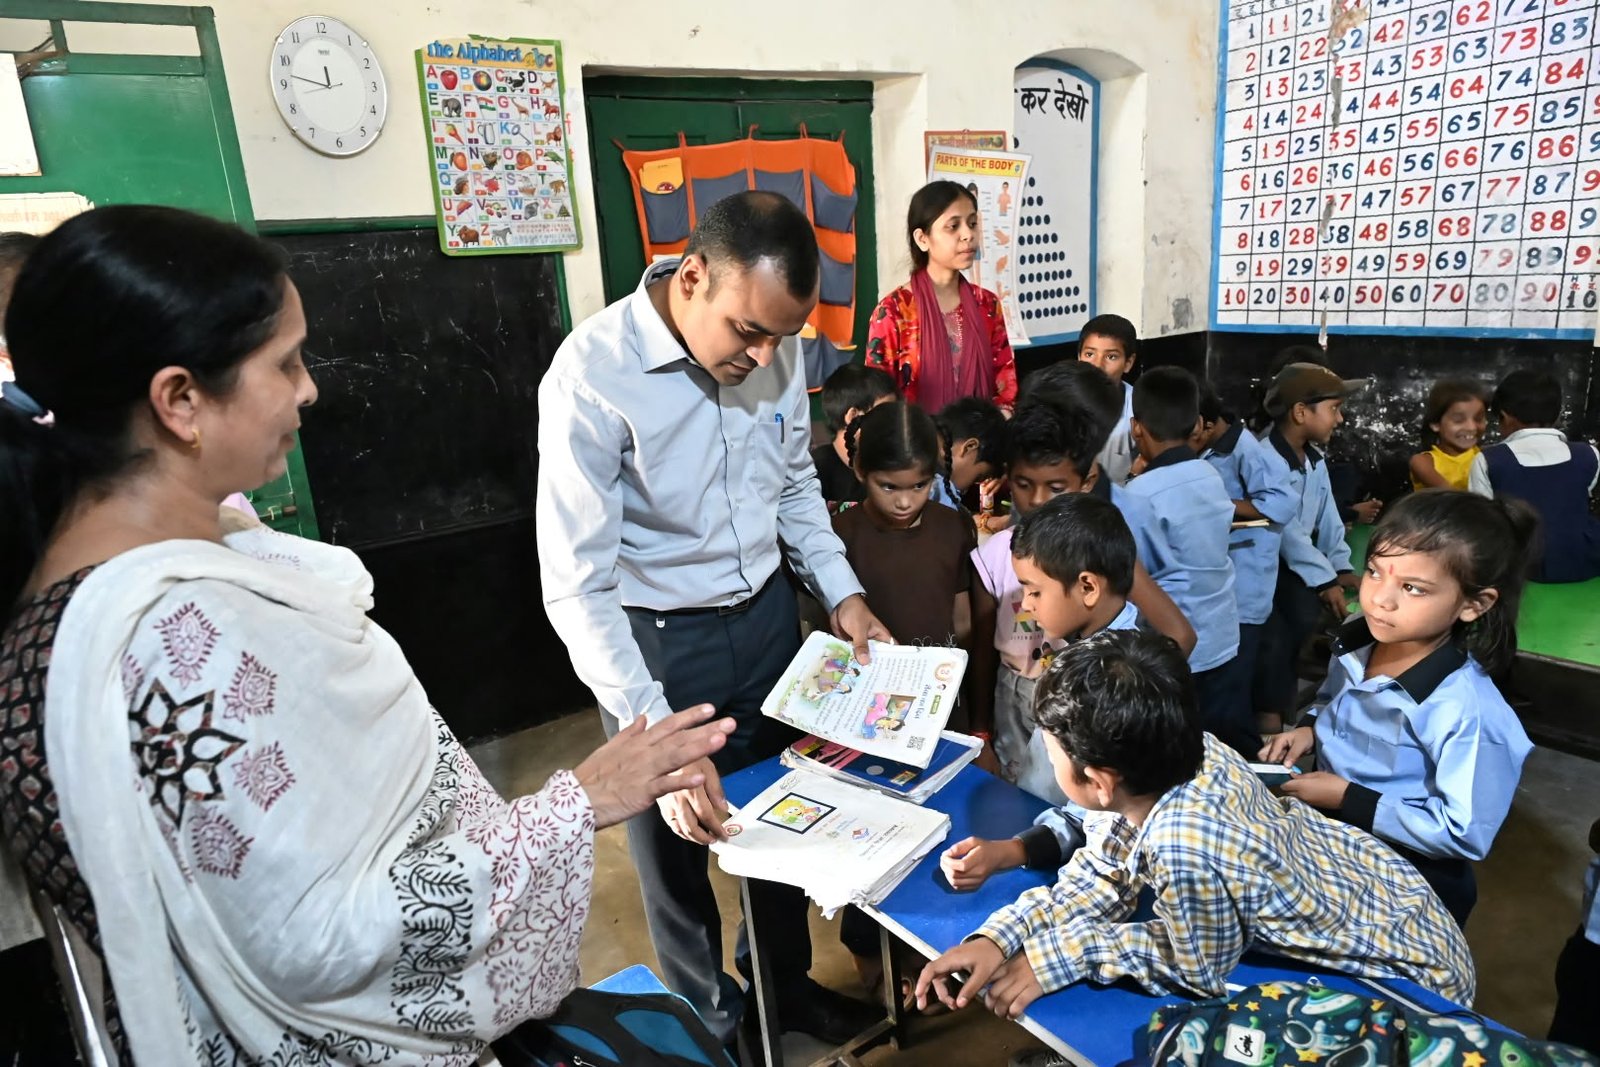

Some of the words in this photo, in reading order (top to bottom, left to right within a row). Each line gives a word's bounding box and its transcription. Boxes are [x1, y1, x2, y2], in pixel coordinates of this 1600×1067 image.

[316, 22, 326, 33] 12
[1249, 23, 1254, 39] 1
[1269, 14, 1288, 35] 11
[1302, 5, 1325, 27] 21
[292, 31, 300, 43] 11
[348, 35, 351, 46] 1
[1246, 52, 1256, 72] 2
[1267, 46, 1290, 67] 12
[1300, 37, 1327, 60] 22
[1374, 20, 1404, 43] 42
[1415, 10, 1447, 35] 52
[1456, 0, 1490, 26] 62
[457, 41, 522, 64] Alphabet
[1245, 83, 1255, 101] 3
[1266, 77, 1288, 98] 13
[1298, 69, 1325, 92] 23
[1372, 54, 1402, 76] 43
[1412, 45, 1444, 70] 53
[1453, 36, 1488, 64] 63
[1500, 27, 1537, 54] 73
[1549, 16, 1589, 45] 83
[280, 55, 291, 66] 10
[363, 58, 370, 69] 2
[426, 65, 438, 79] A
[460, 67, 471, 79] B
[495, 69, 505, 82] C
[528, 71, 537, 83] D
[280, 79, 287, 89] 9
[371, 82, 377, 92] 3
[429, 92, 439, 105] E
[463, 94, 471, 106] F
[498, 96, 509, 108] G
[531, 97, 540, 109] H
[1021, 87, 1050, 114] कर
[1054, 78, 1089, 122] देखो
[1243, 115, 1253, 130] 4
[1264, 110, 1288, 129] 14
[1296, 103, 1322, 124] 24
[1368, 90, 1399, 110] 44
[1410, 82, 1440, 105] 54
[1450, 75, 1484, 98] 64
[1497, 67, 1532, 91] 74
[1545, 58, 1584, 84] 84
[290, 104, 296, 114] 8
[370, 105, 376, 115] 4
[309, 128, 315, 138] 7
[360, 126, 366, 137] 5
[432, 120, 436, 132] I
[467, 121, 474, 133] J
[501, 122, 510, 134] K
[533, 123, 542, 134] L
[1242, 145, 1252, 162] 5
[1263, 140, 1286, 159] 15
[1294, 134, 1320, 155] 25
[1329, 129, 1356, 150] 35
[1366, 123, 1396, 144] 45
[1406, 117, 1438, 139] 55
[1447, 111, 1482, 134] 65
[1494, 103, 1530, 128] 75
[1540, 96, 1581, 124] 85
[336, 137, 342, 148] 6
[436, 146, 447, 158] M
[469, 147, 480, 160] N
[503, 148, 514, 160] O
[535, 148, 544, 160] P
[936, 155, 958, 167] PARTS
[960, 158, 968, 167] OF
[971, 159, 987, 169] THE
[989, 160, 1014, 170] BODY
[1240, 174, 1250, 191] 6
[1261, 170, 1284, 189] 16
[1292, 166, 1318, 186] 26
[1326, 162, 1354, 186] 36
[1364, 157, 1393, 176] 46
[1403, 152, 1435, 172] 56
[1445, 146, 1478, 168] 66
[1490, 140, 1526, 162] 76
[1537, 135, 1575, 159] 86
[440, 172, 451, 185] Q
[474, 173, 483, 185] R
[507, 174, 516, 185] S
[538, 173, 546, 184] T
[1240, 204, 1250, 220] 7
[1260, 200, 1282, 218] 17
[1291, 196, 1317, 216] 27
[1362, 189, 1391, 209] 47
[1400, 186, 1432, 206] 57
[1442, 180, 1476, 203] 67
[1487, 176, 1521, 198] 77
[1533, 172, 1571, 195] 87
[442, 199, 453, 211] U
[477, 199, 486, 210] V
[510, 197, 523, 210] W
[542, 198, 551, 209] X
[447, 224, 456, 237] Y
[481, 223, 490, 235] Z
[1238, 232, 1248, 249] 8
[1258, 230, 1280, 248] 18
[1289, 227, 1315, 245] 28
[1322, 225, 1350, 244] 38
[1359, 222, 1388, 242] 48
[1398, 219, 1428, 239] 58
[1438, 216, 1470, 236] 68
[1482, 213, 1516, 234] 78
[1530, 210, 1566, 232] 88
[1236, 261, 1247, 276] 9
[1255, 260, 1280, 276] 19
[1288, 258, 1313, 276] 29
[1321, 256, 1348, 276] 39
[1356, 254, 1385, 272] 49
[1395, 253, 1426, 272] 59
[1436, 250, 1467, 270] 69
[1481, 249, 1513, 267] 79
[1526, 246, 1563, 268] 89
[1225, 288, 1246, 305] 10
[1254, 288, 1276, 304] 20
[1285, 286, 1310, 304] 30
[1319, 286, 1344, 304] 40
[1354, 285, 1382, 304] 50
[1392, 284, 1421, 303] 60
[1432, 284, 1464, 303] 70
[1475, 283, 1508, 304] 80
[1521, 283, 1557, 302] 90
